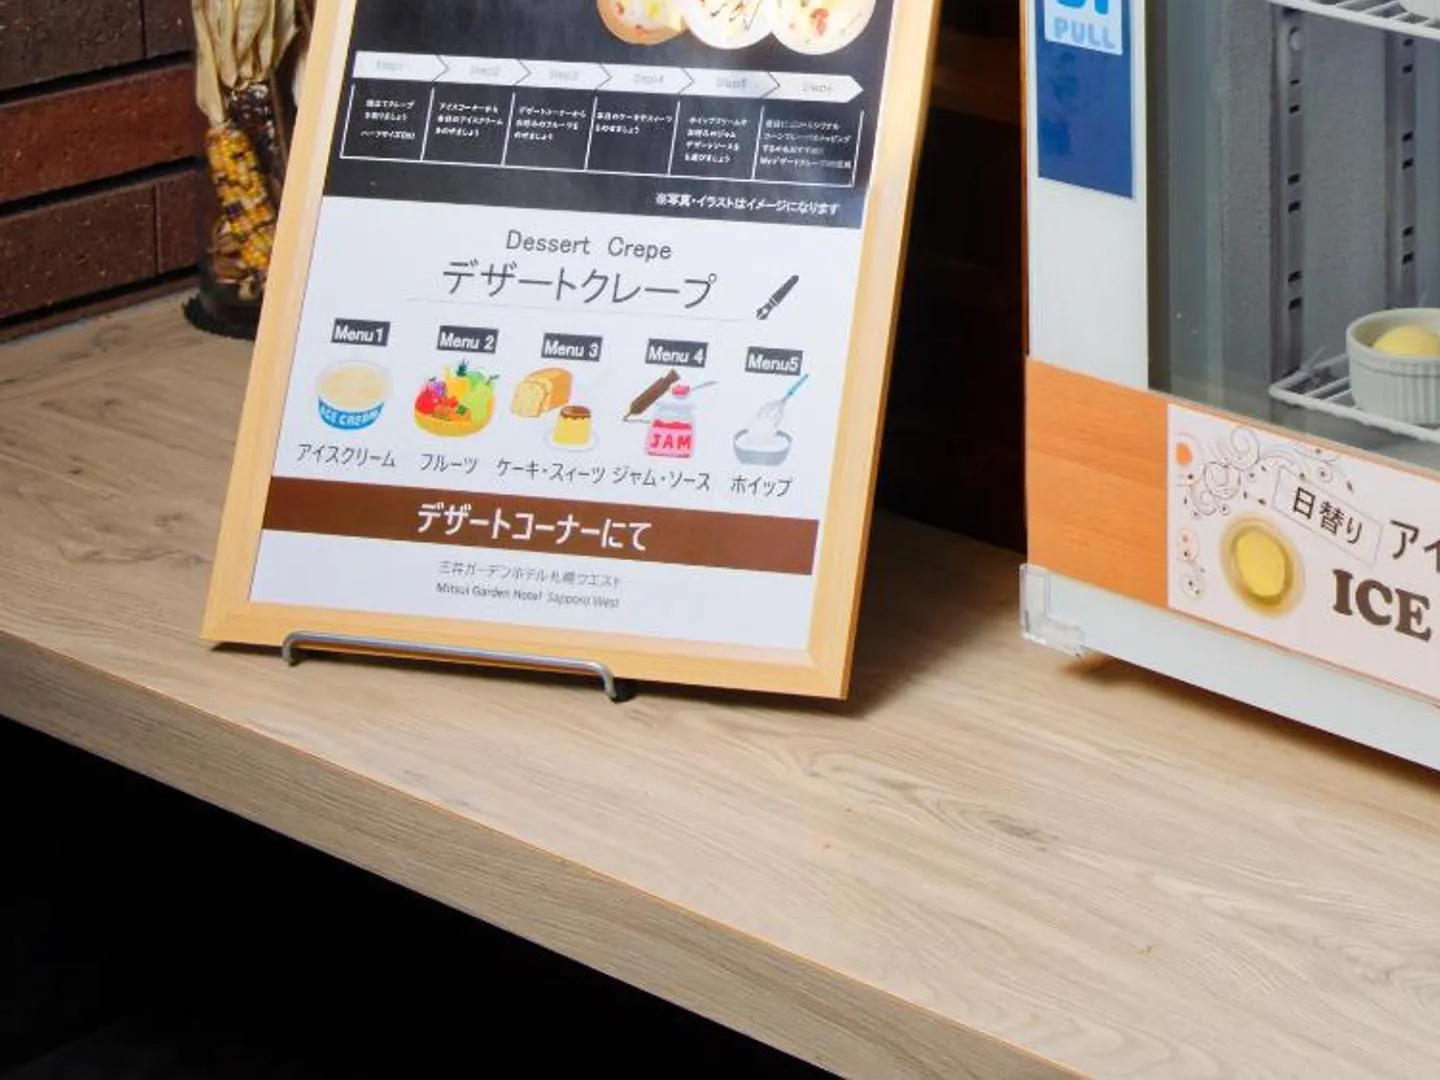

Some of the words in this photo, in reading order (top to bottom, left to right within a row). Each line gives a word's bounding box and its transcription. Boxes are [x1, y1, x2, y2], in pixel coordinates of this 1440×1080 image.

[1053, 17, 1116, 50] PULL
[506, 229, 590, 256] Dessert
[608, 236, 673, 263] Crepe
[443, 259, 718, 309] デザートクレープ
[439, 331, 479, 350] Menu
[483, 335, 495, 351] 2
[544, 339, 585, 357] Menu
[588, 343, 599, 358] 3
[649, 345, 690, 364] Menu
[693, 349, 704, 365] 4
[650, 433, 692, 450] JAM
[297, 443, 397, 468] アイスクリーム
[420, 452, 480, 474] フルーツ
[612, 466, 710, 491] ジャム・ソース
[731, 474, 795, 497] ホイップ
[417, 501, 652, 551] デザートコーナーにて
[1292, 486, 1363, 545] 日替り
[1332, 568, 1432, 642] ICE
